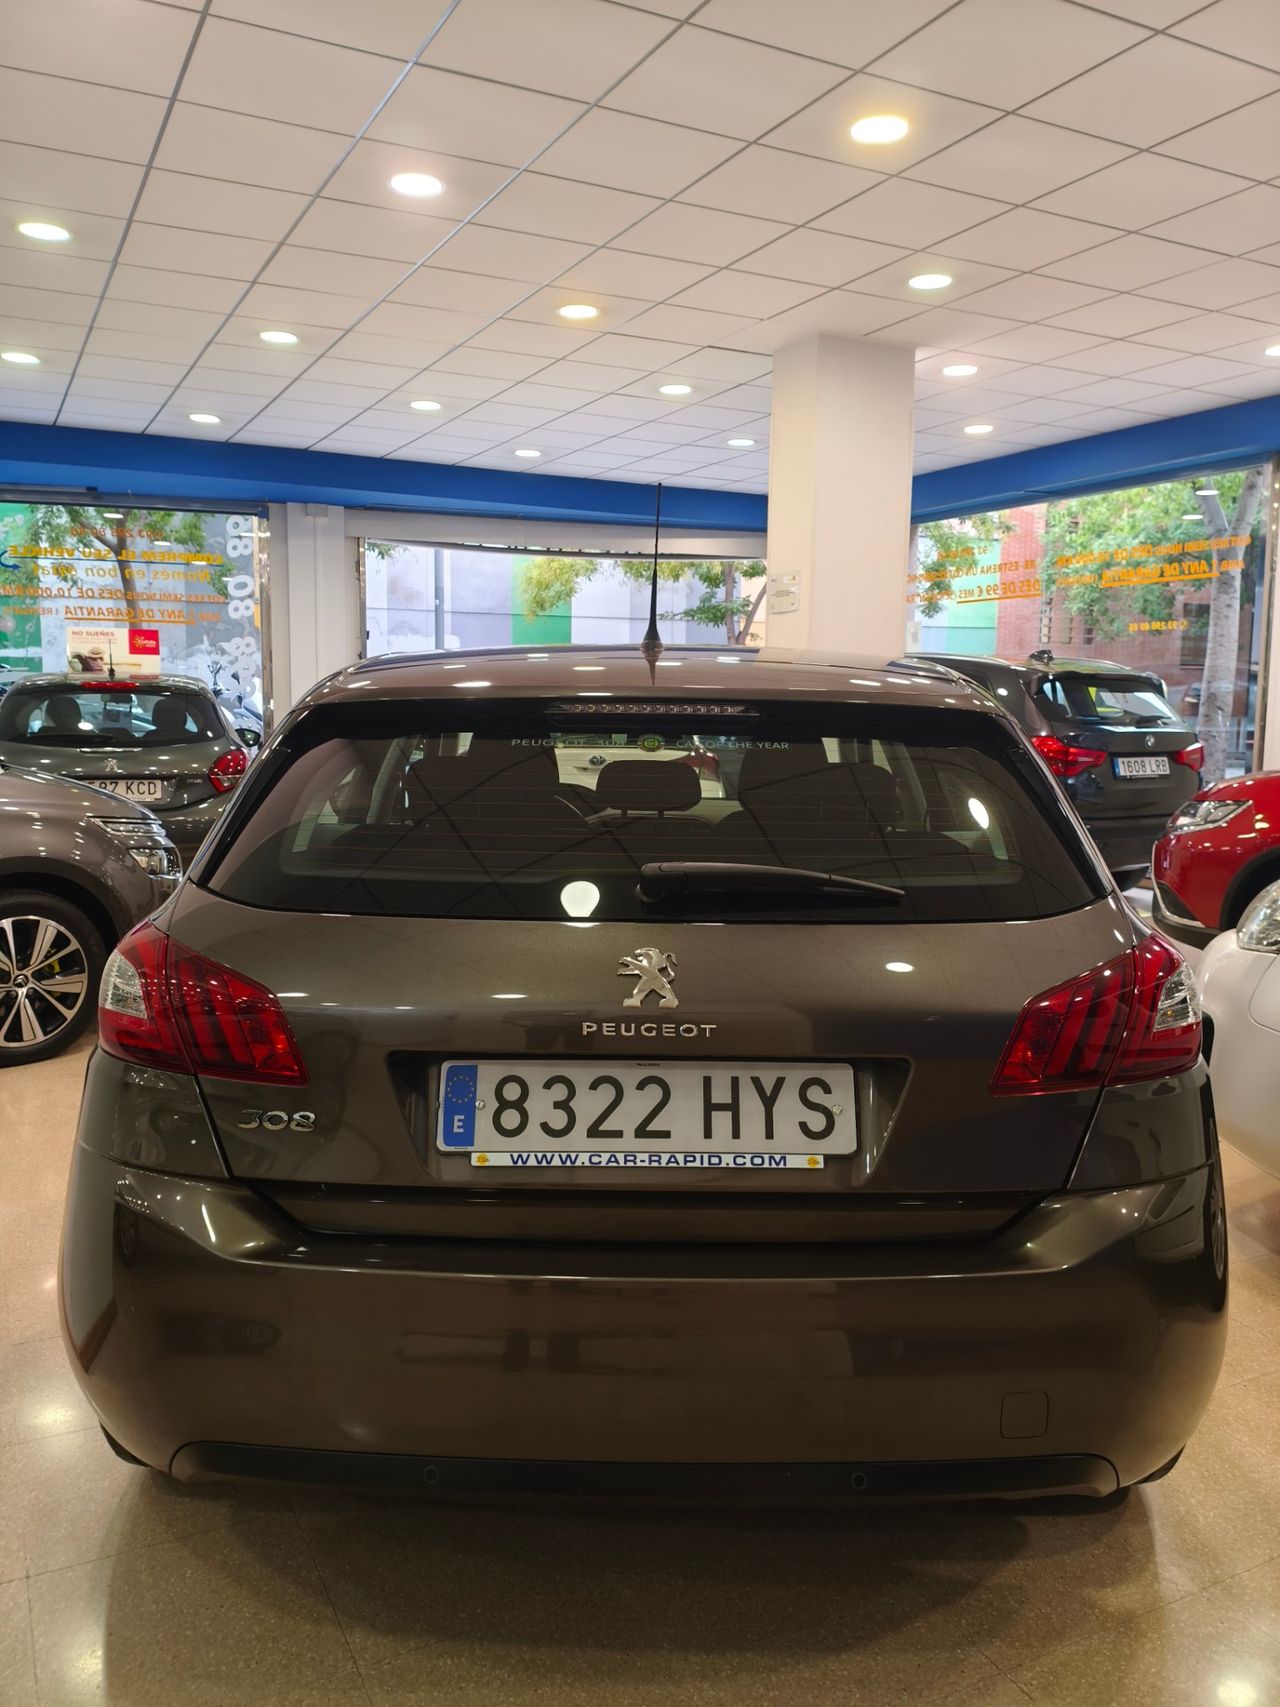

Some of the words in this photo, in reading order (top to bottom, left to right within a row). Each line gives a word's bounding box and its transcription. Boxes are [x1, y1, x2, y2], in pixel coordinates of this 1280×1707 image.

[510, 738, 584, 747] PEUGEOT
[756, 741, 791, 751] YEAR
[1121, 760, 1147, 774] 1608
[1149, 759, 1168, 773] LRB
[125, 781, 157, 796] KCD
[581, 1022, 717, 1038] PEUGEOT
[491, 1074, 672, 1139] 8322
[702, 1075, 837, 1141] HYS
[237, 1109, 316, 1132] 308
[452, 1114, 465, 1133] E
[509, 1153, 788, 1167] WWW.CAR-RAPID.COM
